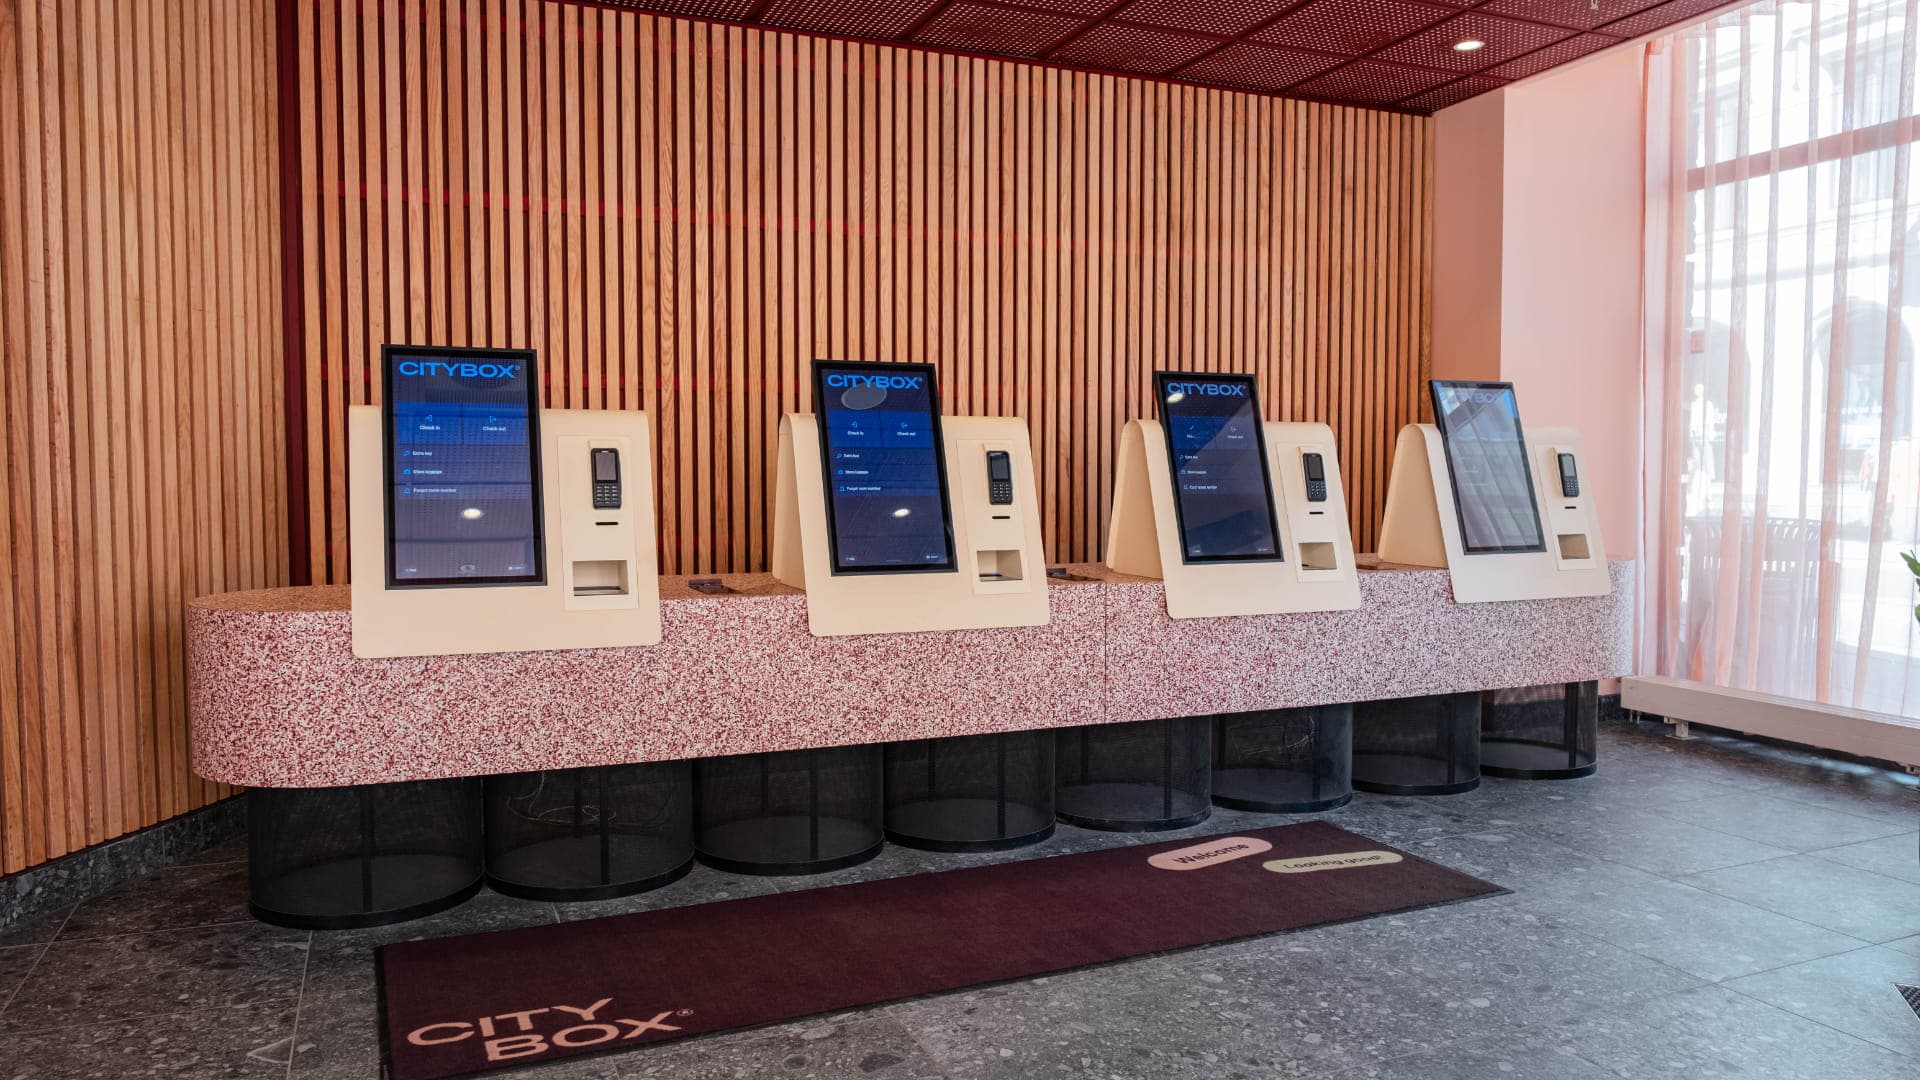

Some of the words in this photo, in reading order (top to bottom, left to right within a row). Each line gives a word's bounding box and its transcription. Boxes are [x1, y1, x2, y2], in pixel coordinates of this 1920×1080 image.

[1172, 844, 1250, 864] Welcome
[1282, 860, 1345, 869] Looking
[406, 997, 613, 1047] CITY
